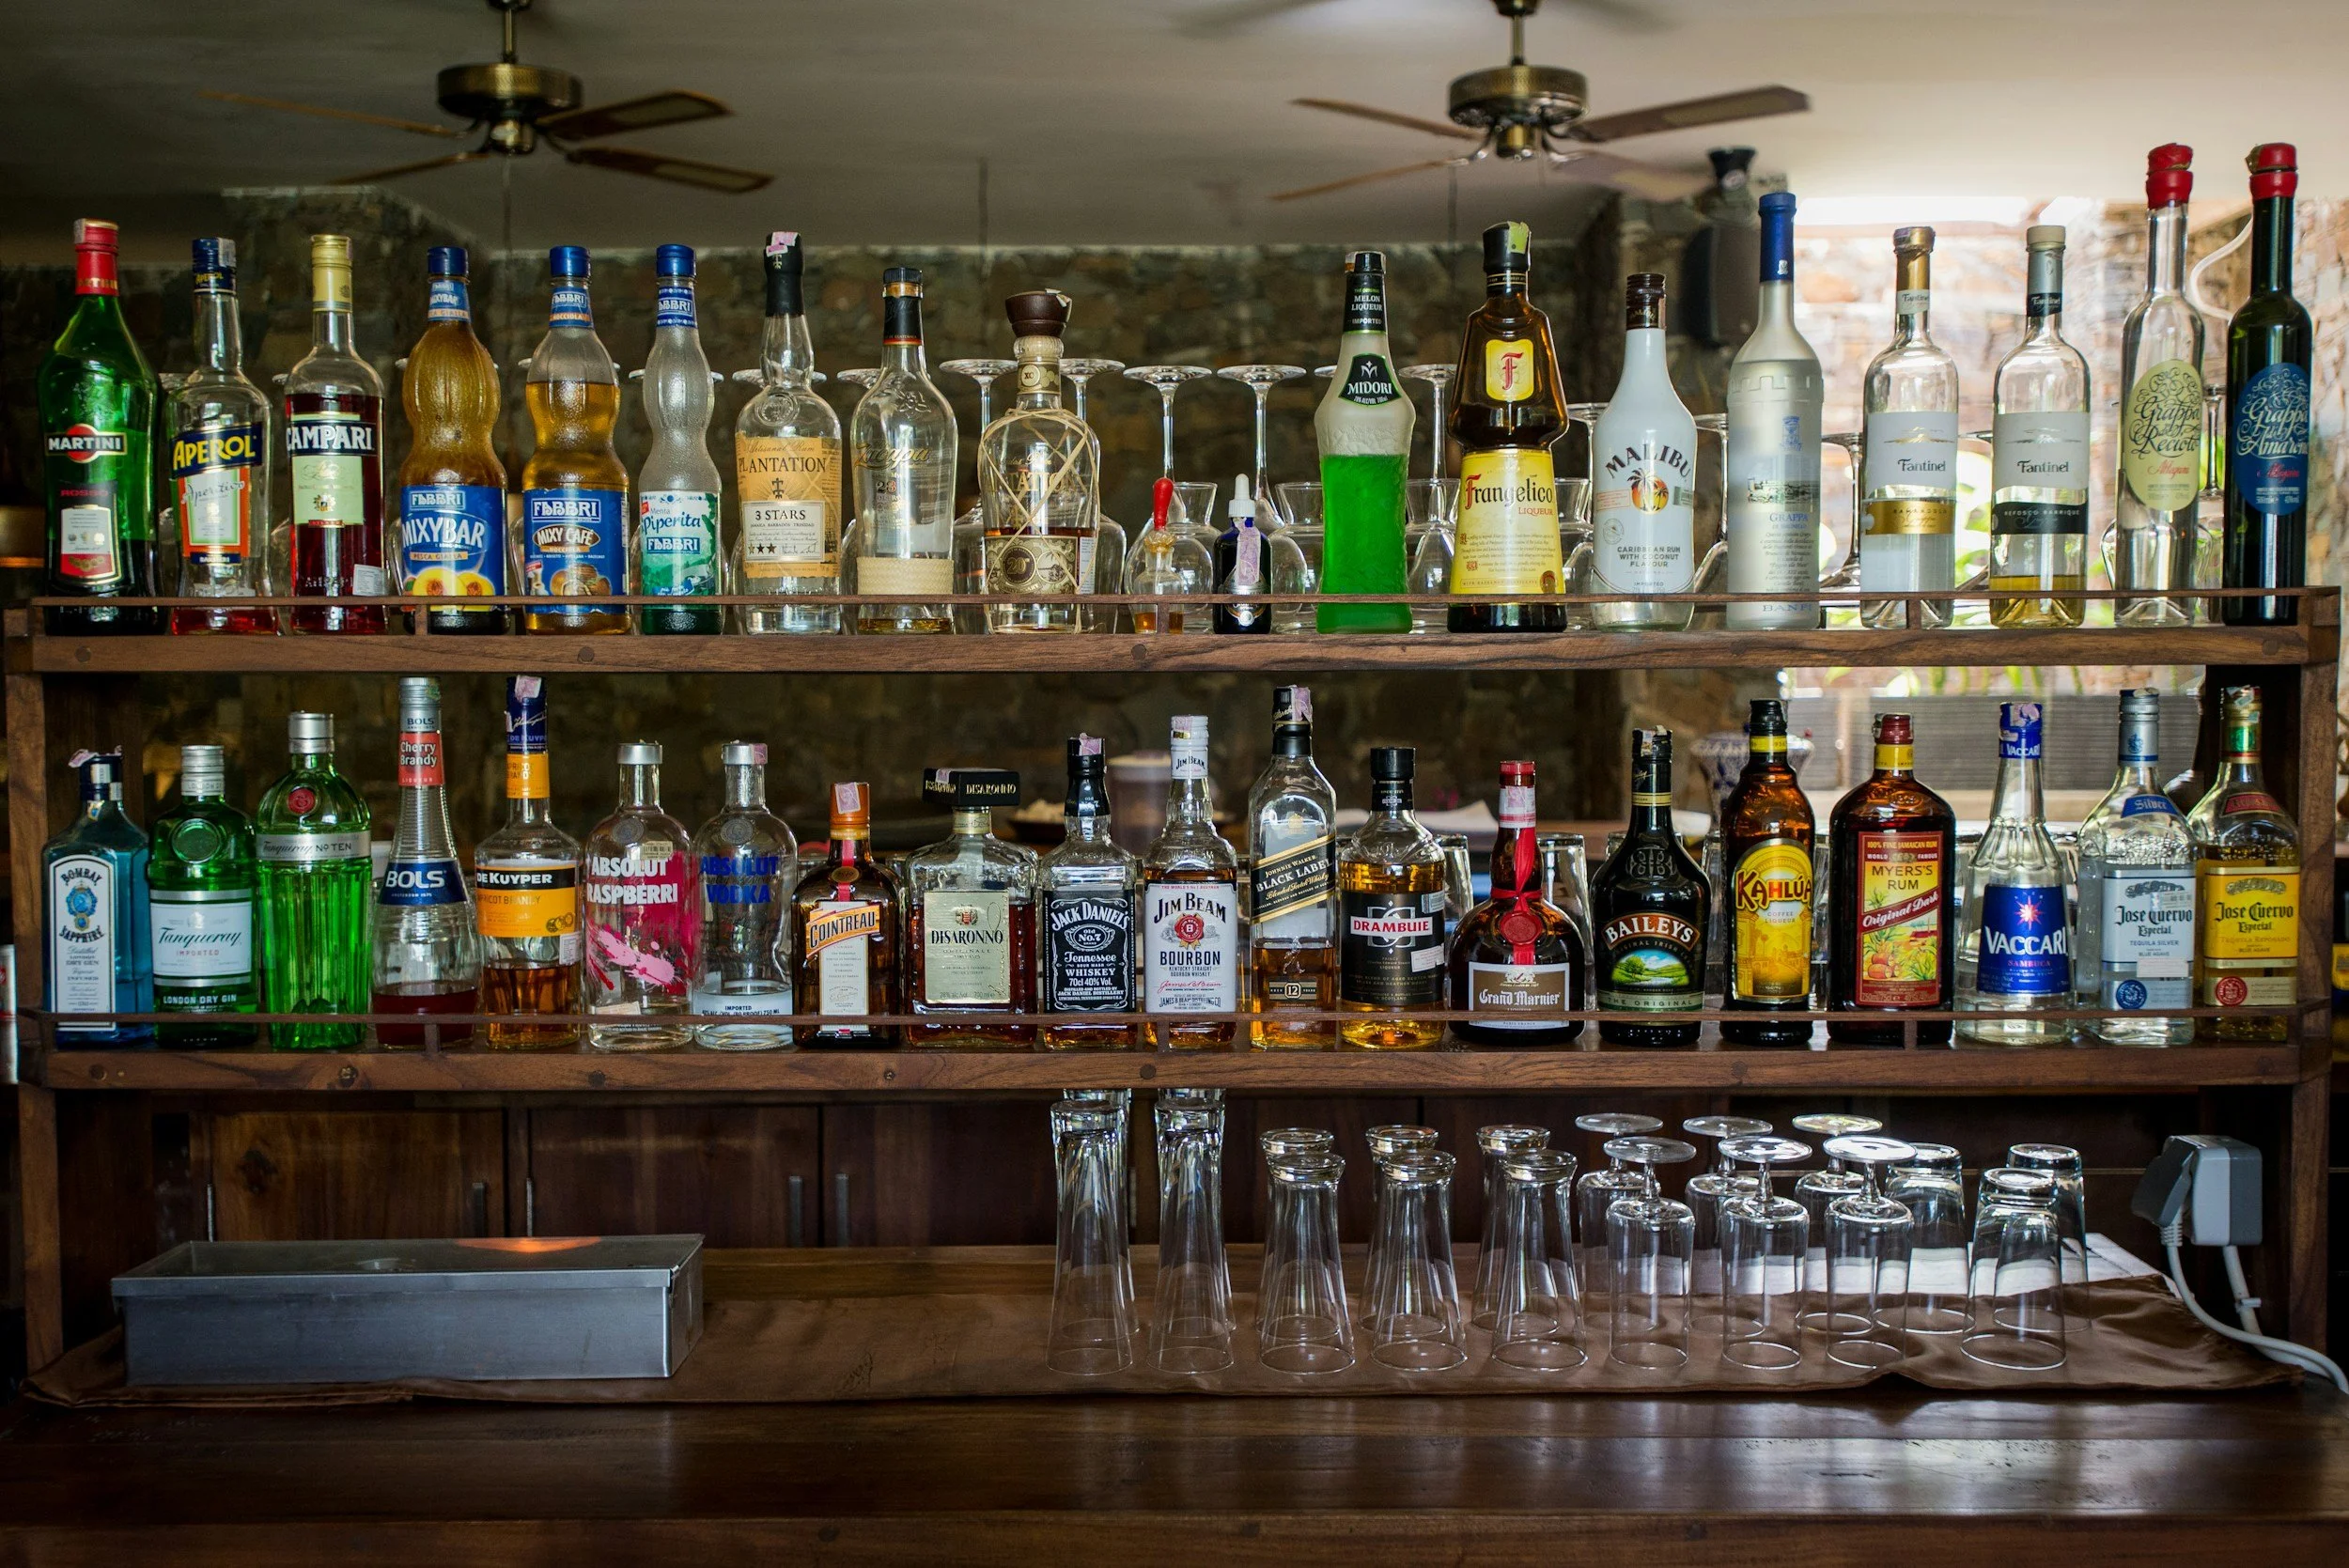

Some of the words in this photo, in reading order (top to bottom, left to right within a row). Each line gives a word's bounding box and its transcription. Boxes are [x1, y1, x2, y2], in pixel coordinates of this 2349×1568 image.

[658, 300, 691, 312] ABBRI
[1351, 303, 1383, 312] LIQUEUR
[1347, 381, 1392, 395] MIDORI
[49, 437, 121, 451] MARTINI
[287, 426, 372, 453] CAMPARI
[173, 435, 256, 470] APEROL
[739, 457, 827, 474] PLANTATION
[1605, 443, 1691, 478] MALIBU
[1898, 458, 1946, 472] Fantinel
[2017, 459, 2069, 474] Fantinel
[180, 480, 244, 507] Apertivo
[412, 492, 460, 505] FABBRI
[1464, 474, 1552, 509] Frangelico
[534, 501, 598, 517] FABBRI
[755, 511, 761, 520] 3
[765, 510, 806, 520] STARS
[1518, 507, 1554, 517] LIQUEUR
[643, 511, 701, 536] Piperita
[1770, 513, 1809, 522] GRAPPA
[402, 517, 485, 549] MIXYBAR
[537, 527, 564, 545] MIXY
[648, 537, 698, 551] FABBRI
[400, 742, 436, 754] Cherry
[400, 754, 437, 768] Brandy
[1175, 759, 1189, 769] JIM
[966, 784, 1017, 795] DISARONNO
[2135, 799, 2167, 810] Silver
[263, 840, 313, 855] Tanqueray
[331, 842, 351, 851] TEN
[592, 857, 667, 877] ABSOLUT
[701, 857, 779, 876] ABSOLUT
[1266, 863, 1292, 877] JOHNNIE
[1292, 855, 1317, 866] WALKER
[1872, 865, 1934, 876] MYERS'S
[61, 868, 102, 887] BOMBAY
[385, 870, 445, 889] BOLS
[477, 872, 488, 883] DE
[490, 872, 552, 885] KUYPER
[1255, 872, 1295, 893] BLACK
[1296, 859, 1332, 877] LABEL
[1736, 869, 1812, 911] KAHLÚA
[1888, 879, 1919, 890] RUM
[586, 883, 678, 905] RASPBERRI
[707, 884, 770, 904] VODKA
[1154, 897, 1182, 924] JIM
[1185, 893, 1226, 923] BEAM
[1862, 903, 1912, 926] Original
[1913, 891, 1938, 911] Dark
[2115, 906, 2146, 925] Jose
[2215, 902, 2246, 922] Jose
[2249, 902, 2294, 921] Cuervo
[1050, 907, 1081, 931] JACK
[1082, 902, 1129, 930] DANIEL'S
[59, 924, 104, 943] SAPPHIRE
[810, 911, 876, 948] COINTREAU
[1187, 924, 1193, 933] B
[1353, 920, 1429, 932] DRAMBUIE
[1605, 917, 1693, 943] BAILEYS
[2139, 925, 2171, 937] Especial
[2238, 922, 2272, 933] Especial
[159, 926, 241, 948] Tanqueray
[931, 930, 1004, 945] DISARONNO
[1078, 934, 1101, 942] No.7
[1984, 925, 2067, 955] VACCARI
[1065, 951, 1116, 963] Tennessee
[1160, 951, 1221, 965] BOURBON
[1069, 978, 1083, 986] 70cl
[1084, 978, 1099, 986] 40%
[1100, 978, 1112, 986] Vol.
[1288, 986, 1298, 995] 12
[1479, 988, 1513, 1005] Grand
[1514, 990, 1560, 1005] Marnier
[163, 996, 195, 1004] LONDON
[222, 994, 237, 1002] GIN
[1159, 998, 1174, 1007] JAMES
